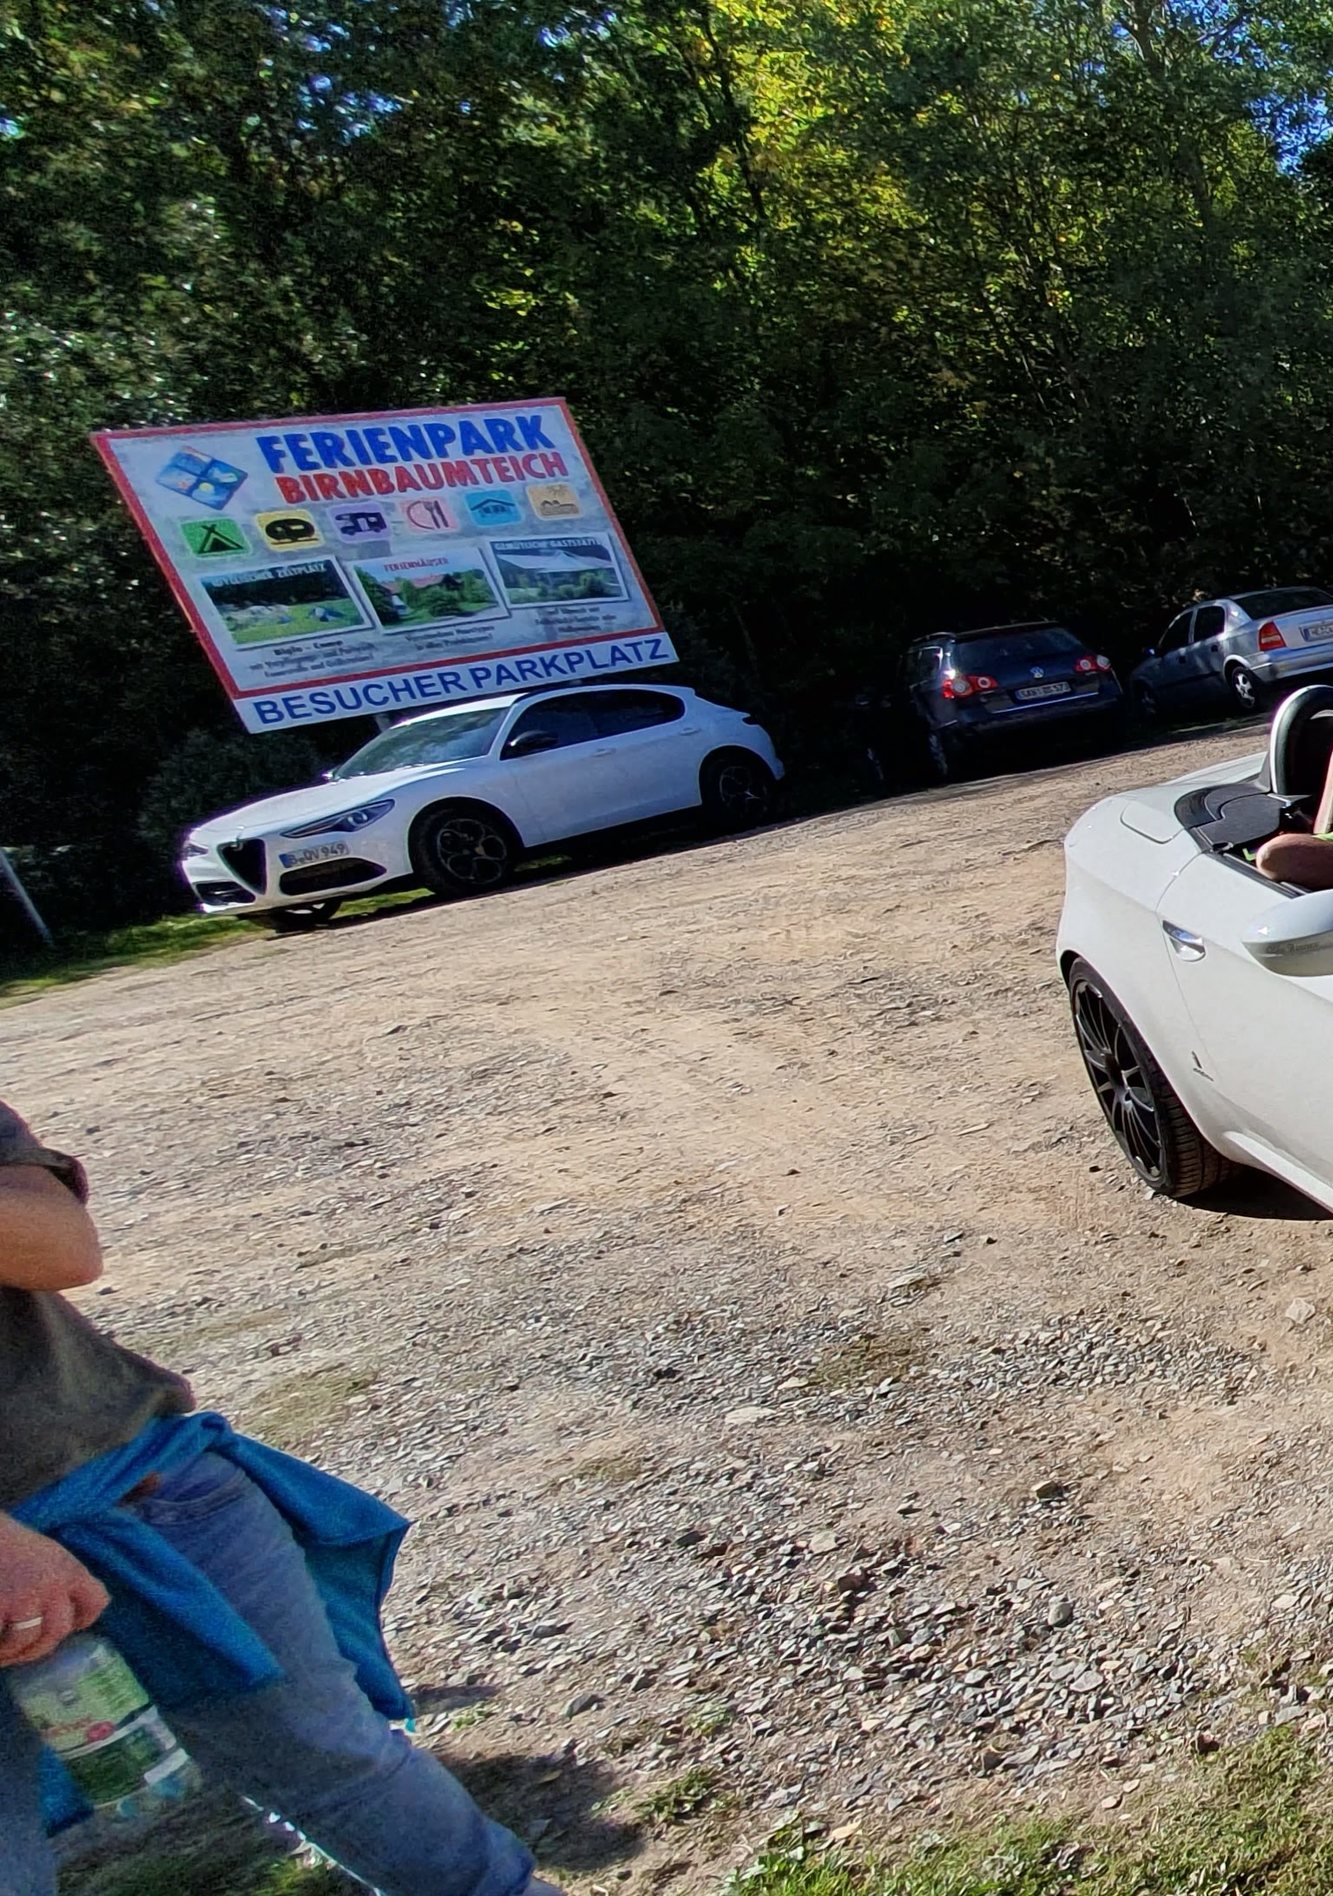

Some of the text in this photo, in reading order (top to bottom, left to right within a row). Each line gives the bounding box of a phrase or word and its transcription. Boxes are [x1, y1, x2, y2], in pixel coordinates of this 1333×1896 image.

[256, 415, 556, 474] FERIENPARK
[275, 452, 569, 504] BIRNBAUMTEICH
[253, 638, 670, 725] BESUCHER PARKPLATZ
